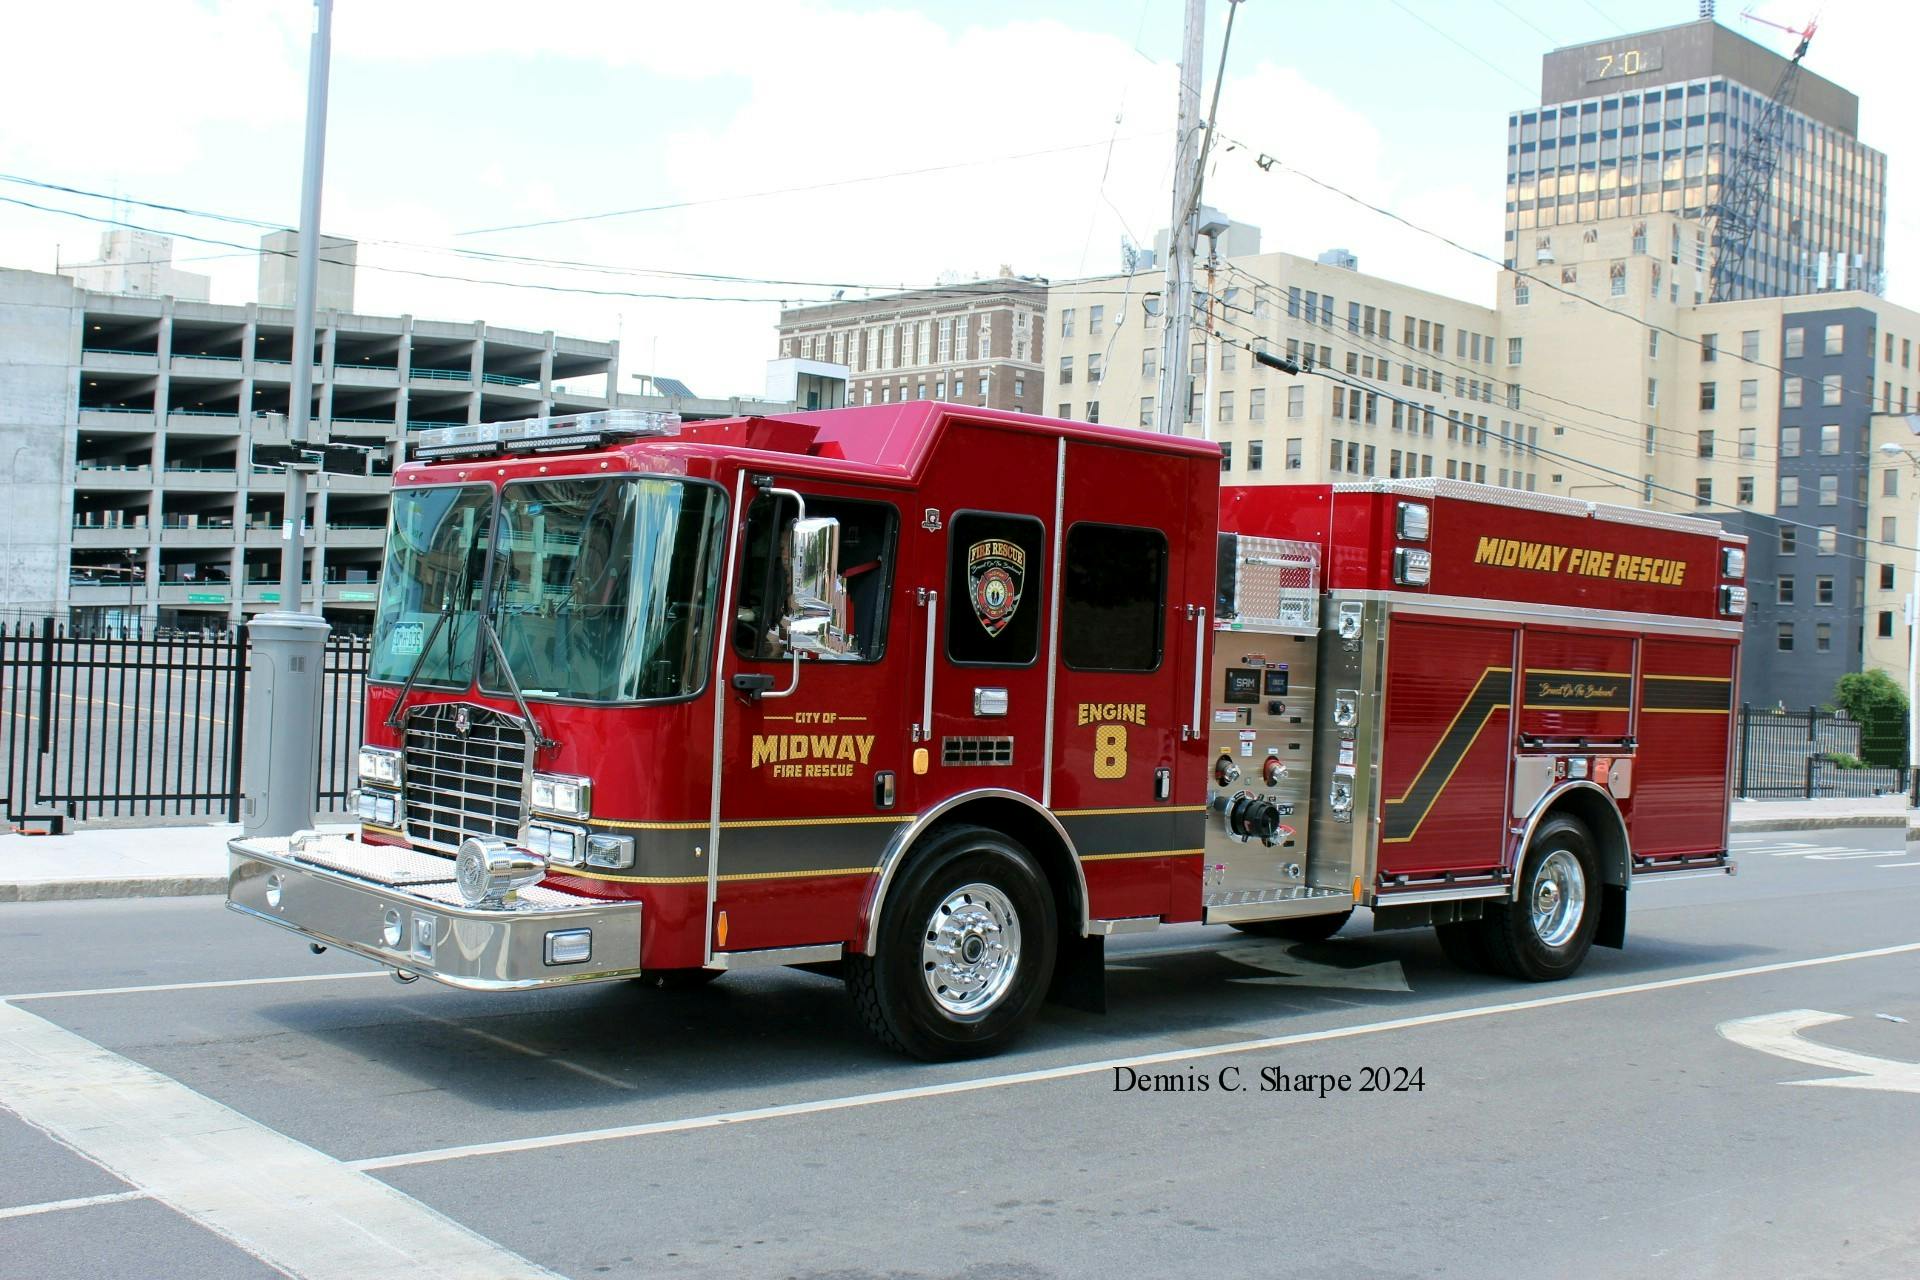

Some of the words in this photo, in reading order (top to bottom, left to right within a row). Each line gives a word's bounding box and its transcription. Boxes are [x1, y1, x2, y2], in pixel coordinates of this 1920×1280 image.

[971, 543, 991, 561] FIRE
[992, 542, 1023, 565] RESCUE
[1474, 536, 1569, 572] MIDWAY
[1566, 548, 1615, 578] FIRE
[1614, 554, 1687, 586] RESCUE
[1236, 678, 1255, 688] SAM
[795, 712, 821, 724] CITY
[822, 712, 837, 724] OF
[1078, 703, 1146, 726] ENGINE
[751, 734, 876, 769] MIDWAY
[1093, 724, 1128, 779] 8
[773, 764, 803, 778] FIRE
[805, 764, 854, 777] RESCUE
